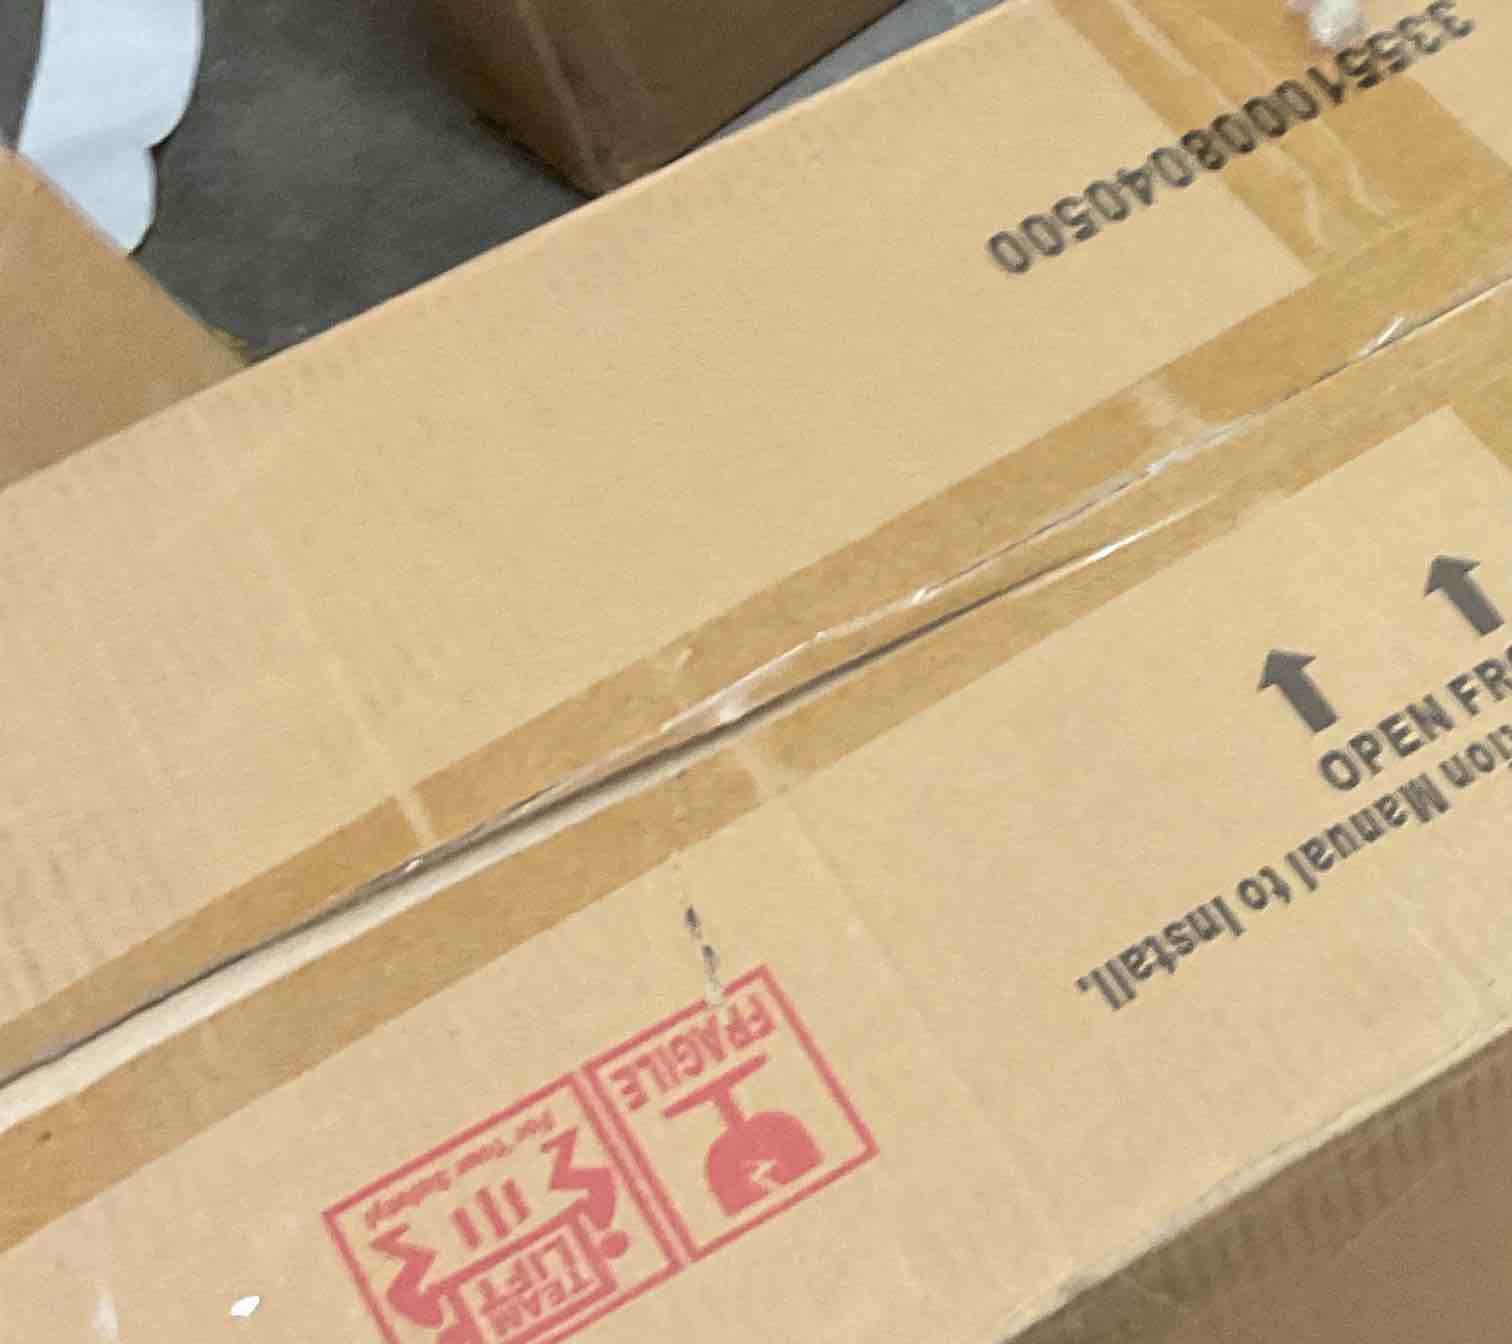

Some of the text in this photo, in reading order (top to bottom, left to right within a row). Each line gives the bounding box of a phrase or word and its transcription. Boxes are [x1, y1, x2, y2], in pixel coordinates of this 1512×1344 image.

[986, 0, 1475, 275] 335510008040500
[1317, 693, 1455, 792] OPEN
[1285, 771, 1451, 893] Manual
[1237, 865, 1292, 911] to
[1075, 895, 1247, 1011] Install.
[609, 991, 776, 1114] FRAGILE
[479, 1232, 573, 1316] LIFT
[492, 1273, 594, 1337] TEAM
